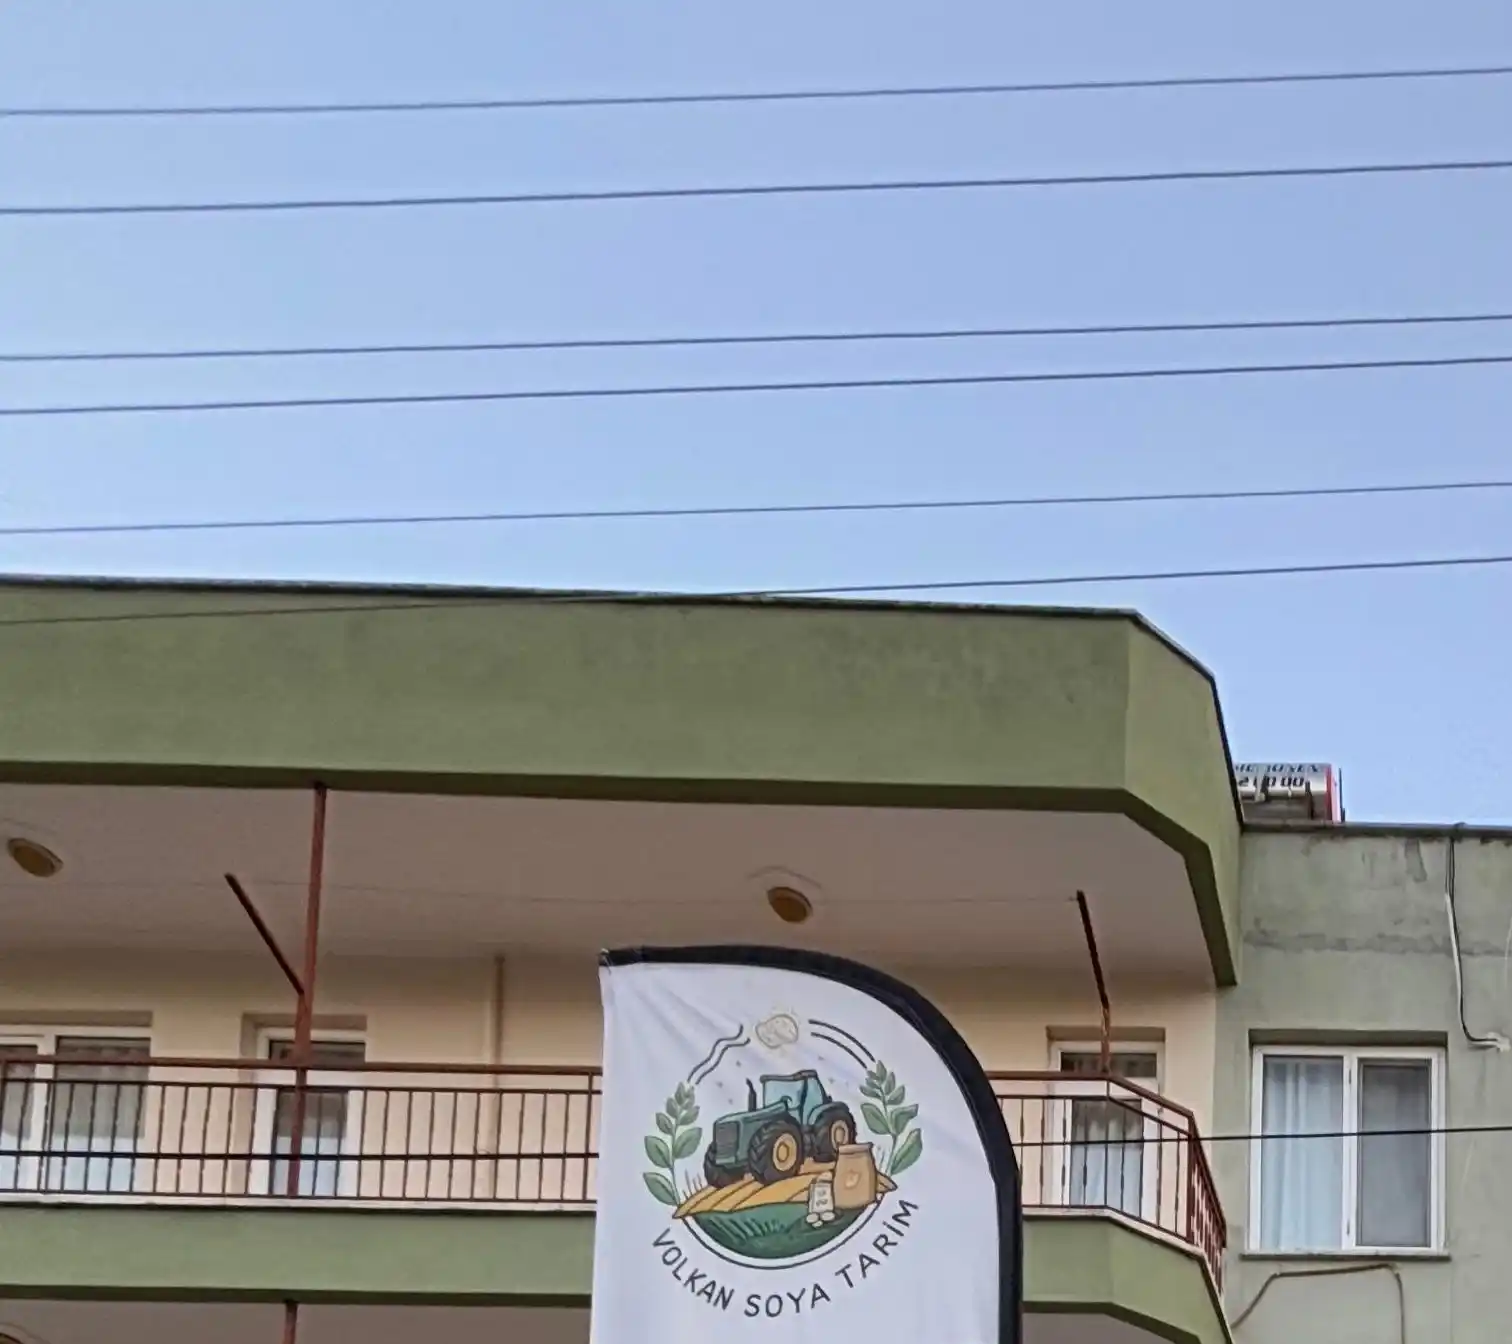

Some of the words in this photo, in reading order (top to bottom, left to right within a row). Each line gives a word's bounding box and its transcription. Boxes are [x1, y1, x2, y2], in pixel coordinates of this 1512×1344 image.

[651, 1227, 735, 1311] VOLKAN
[743, 1283, 831, 1318] SOYA
[834, 1198, 920, 1290] TARİM
